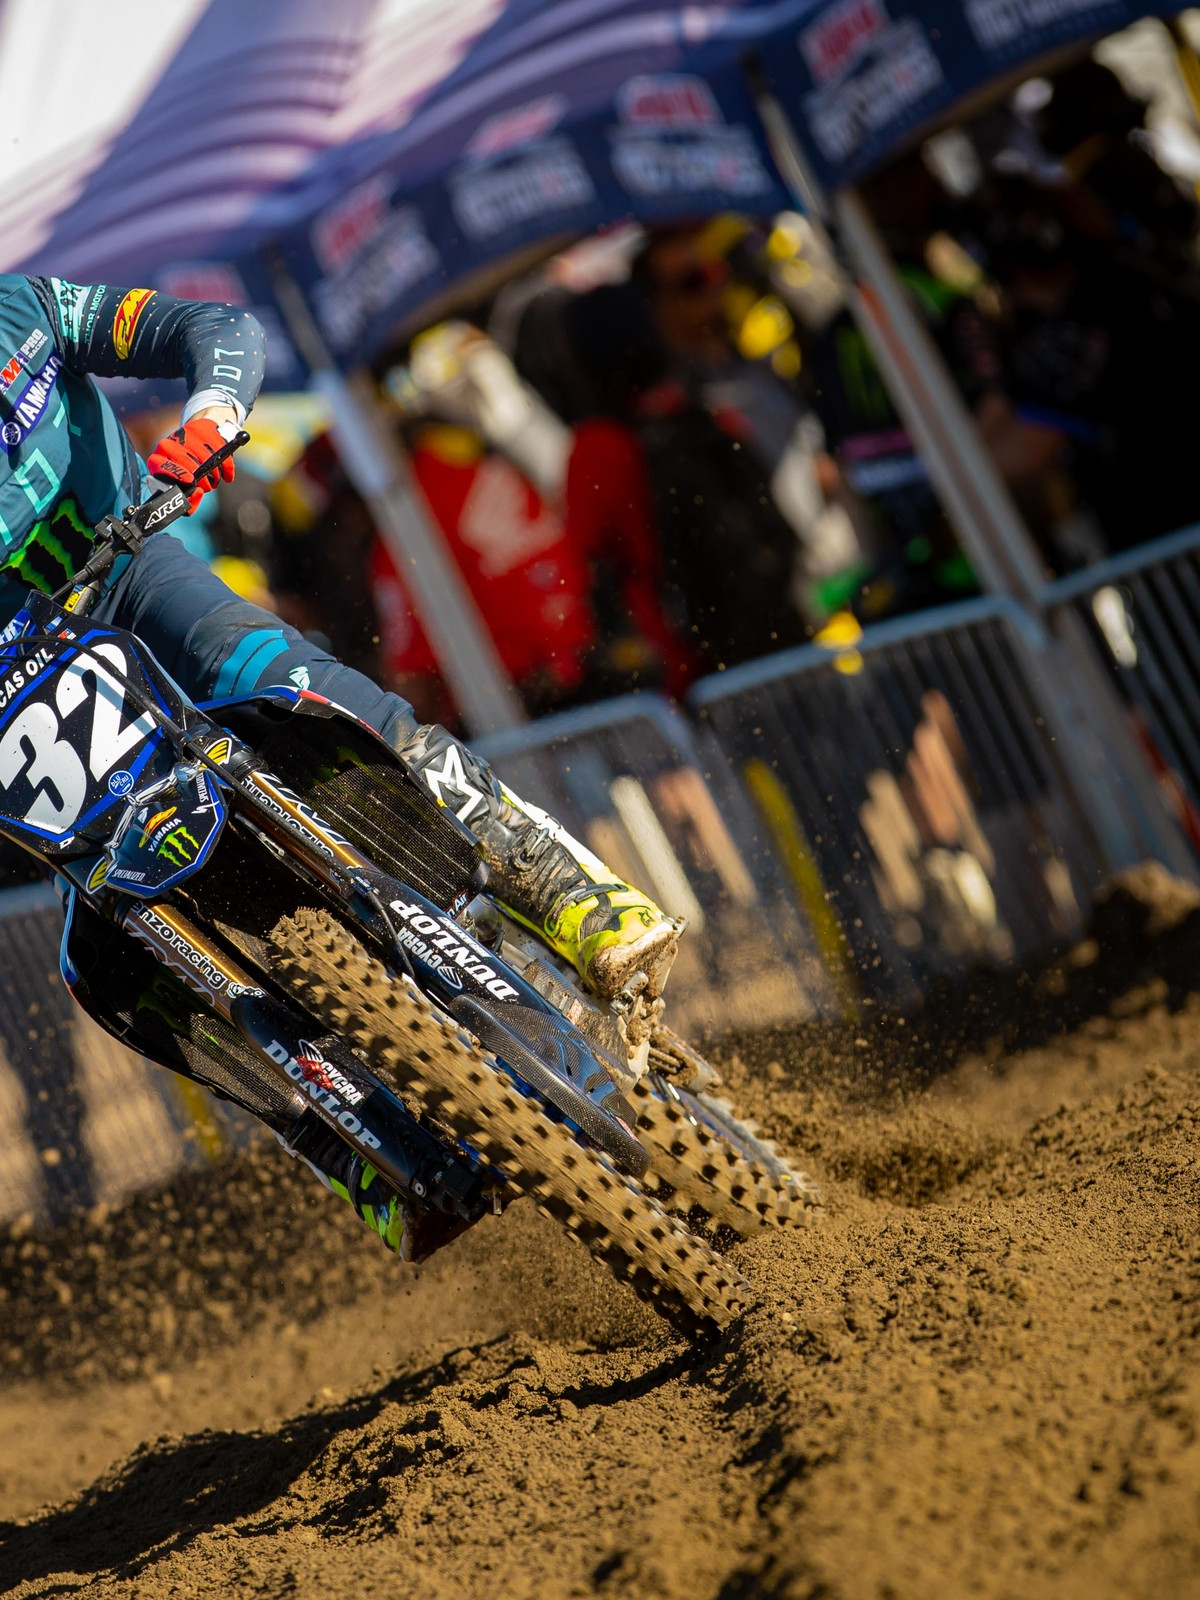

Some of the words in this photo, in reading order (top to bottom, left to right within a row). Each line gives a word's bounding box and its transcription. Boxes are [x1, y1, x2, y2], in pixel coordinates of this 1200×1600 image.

[20, 328, 43, 356] PRO
[28, 335, 48, 360] RACING
[14, 355, 63, 430] YAMAHA
[160, 461, 188, 479] THOR
[144, 492, 184, 530] ARC
[25, 647, 54, 677] OIL
[148, 817, 182, 852] YAMAHA
[112, 868, 146, 882] SPECIALIZED
[389, 900, 519, 1001] DUNLOP
[397, 927, 443, 969] CYCRA
[262, 1039, 382, 1150] DUNLOP
[321, 1060, 365, 1106] CYCRA
